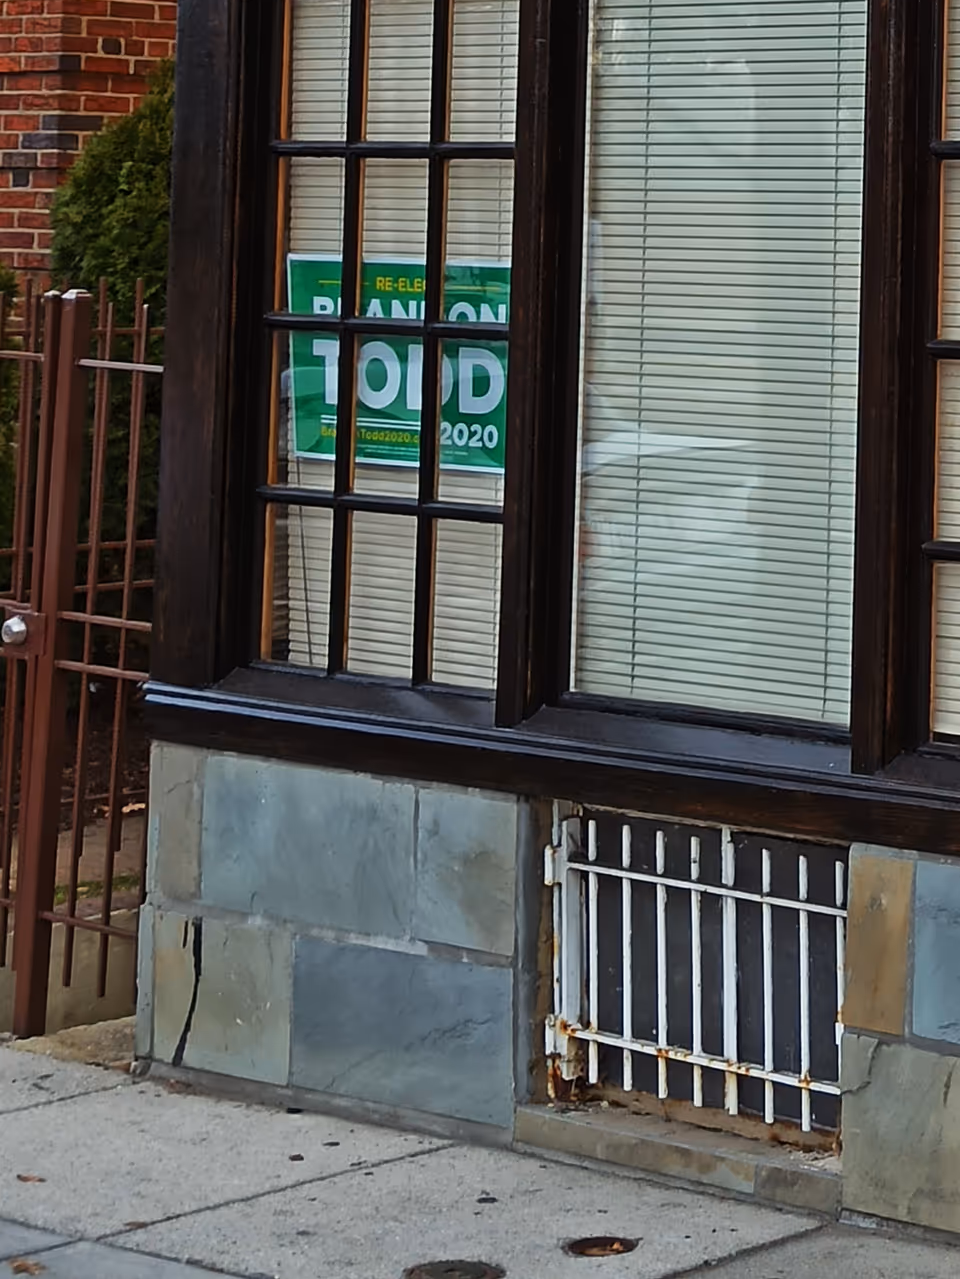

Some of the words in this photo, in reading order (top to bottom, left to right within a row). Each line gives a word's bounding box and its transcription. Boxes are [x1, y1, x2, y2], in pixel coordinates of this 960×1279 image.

[376, 276, 426, 293] RE-ELE
[312, 295, 507, 324] BANON
[440, 422, 499, 449] 2020
